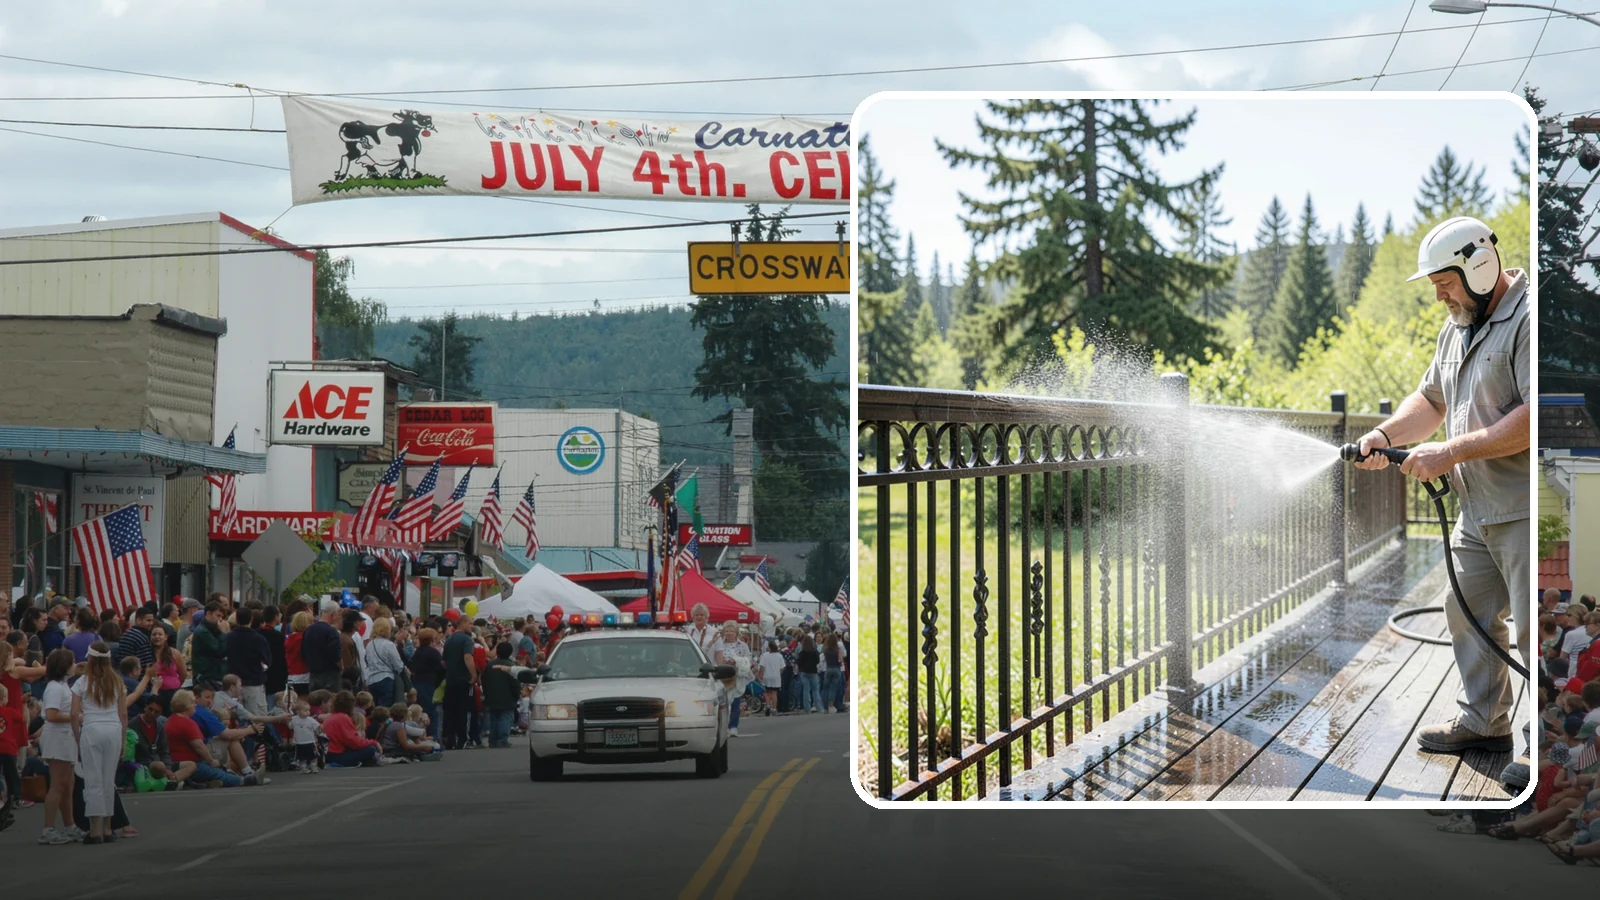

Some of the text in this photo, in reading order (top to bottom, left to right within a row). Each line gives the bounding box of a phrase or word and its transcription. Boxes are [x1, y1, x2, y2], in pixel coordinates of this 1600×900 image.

[695, 122, 850, 149] Carnat
[481, 141, 605, 192] JULY
[632, 150, 746, 198] 4th.
[697, 255, 850, 280] CROSSWA
[283, 380, 373, 420] ACE
[406, 409, 485, 422] CEDAR LOG
[283, 421, 371, 436] Hardware
[416, 428, 477, 447] Coca-Cola
[353, 467, 384, 481] Simpl
[83, 485, 155, 495] St. Vincent de Paul
[81, 503, 154, 522] THRT
[688, 526, 741, 535] CRNATION
[699, 535, 730, 543] GLASS
